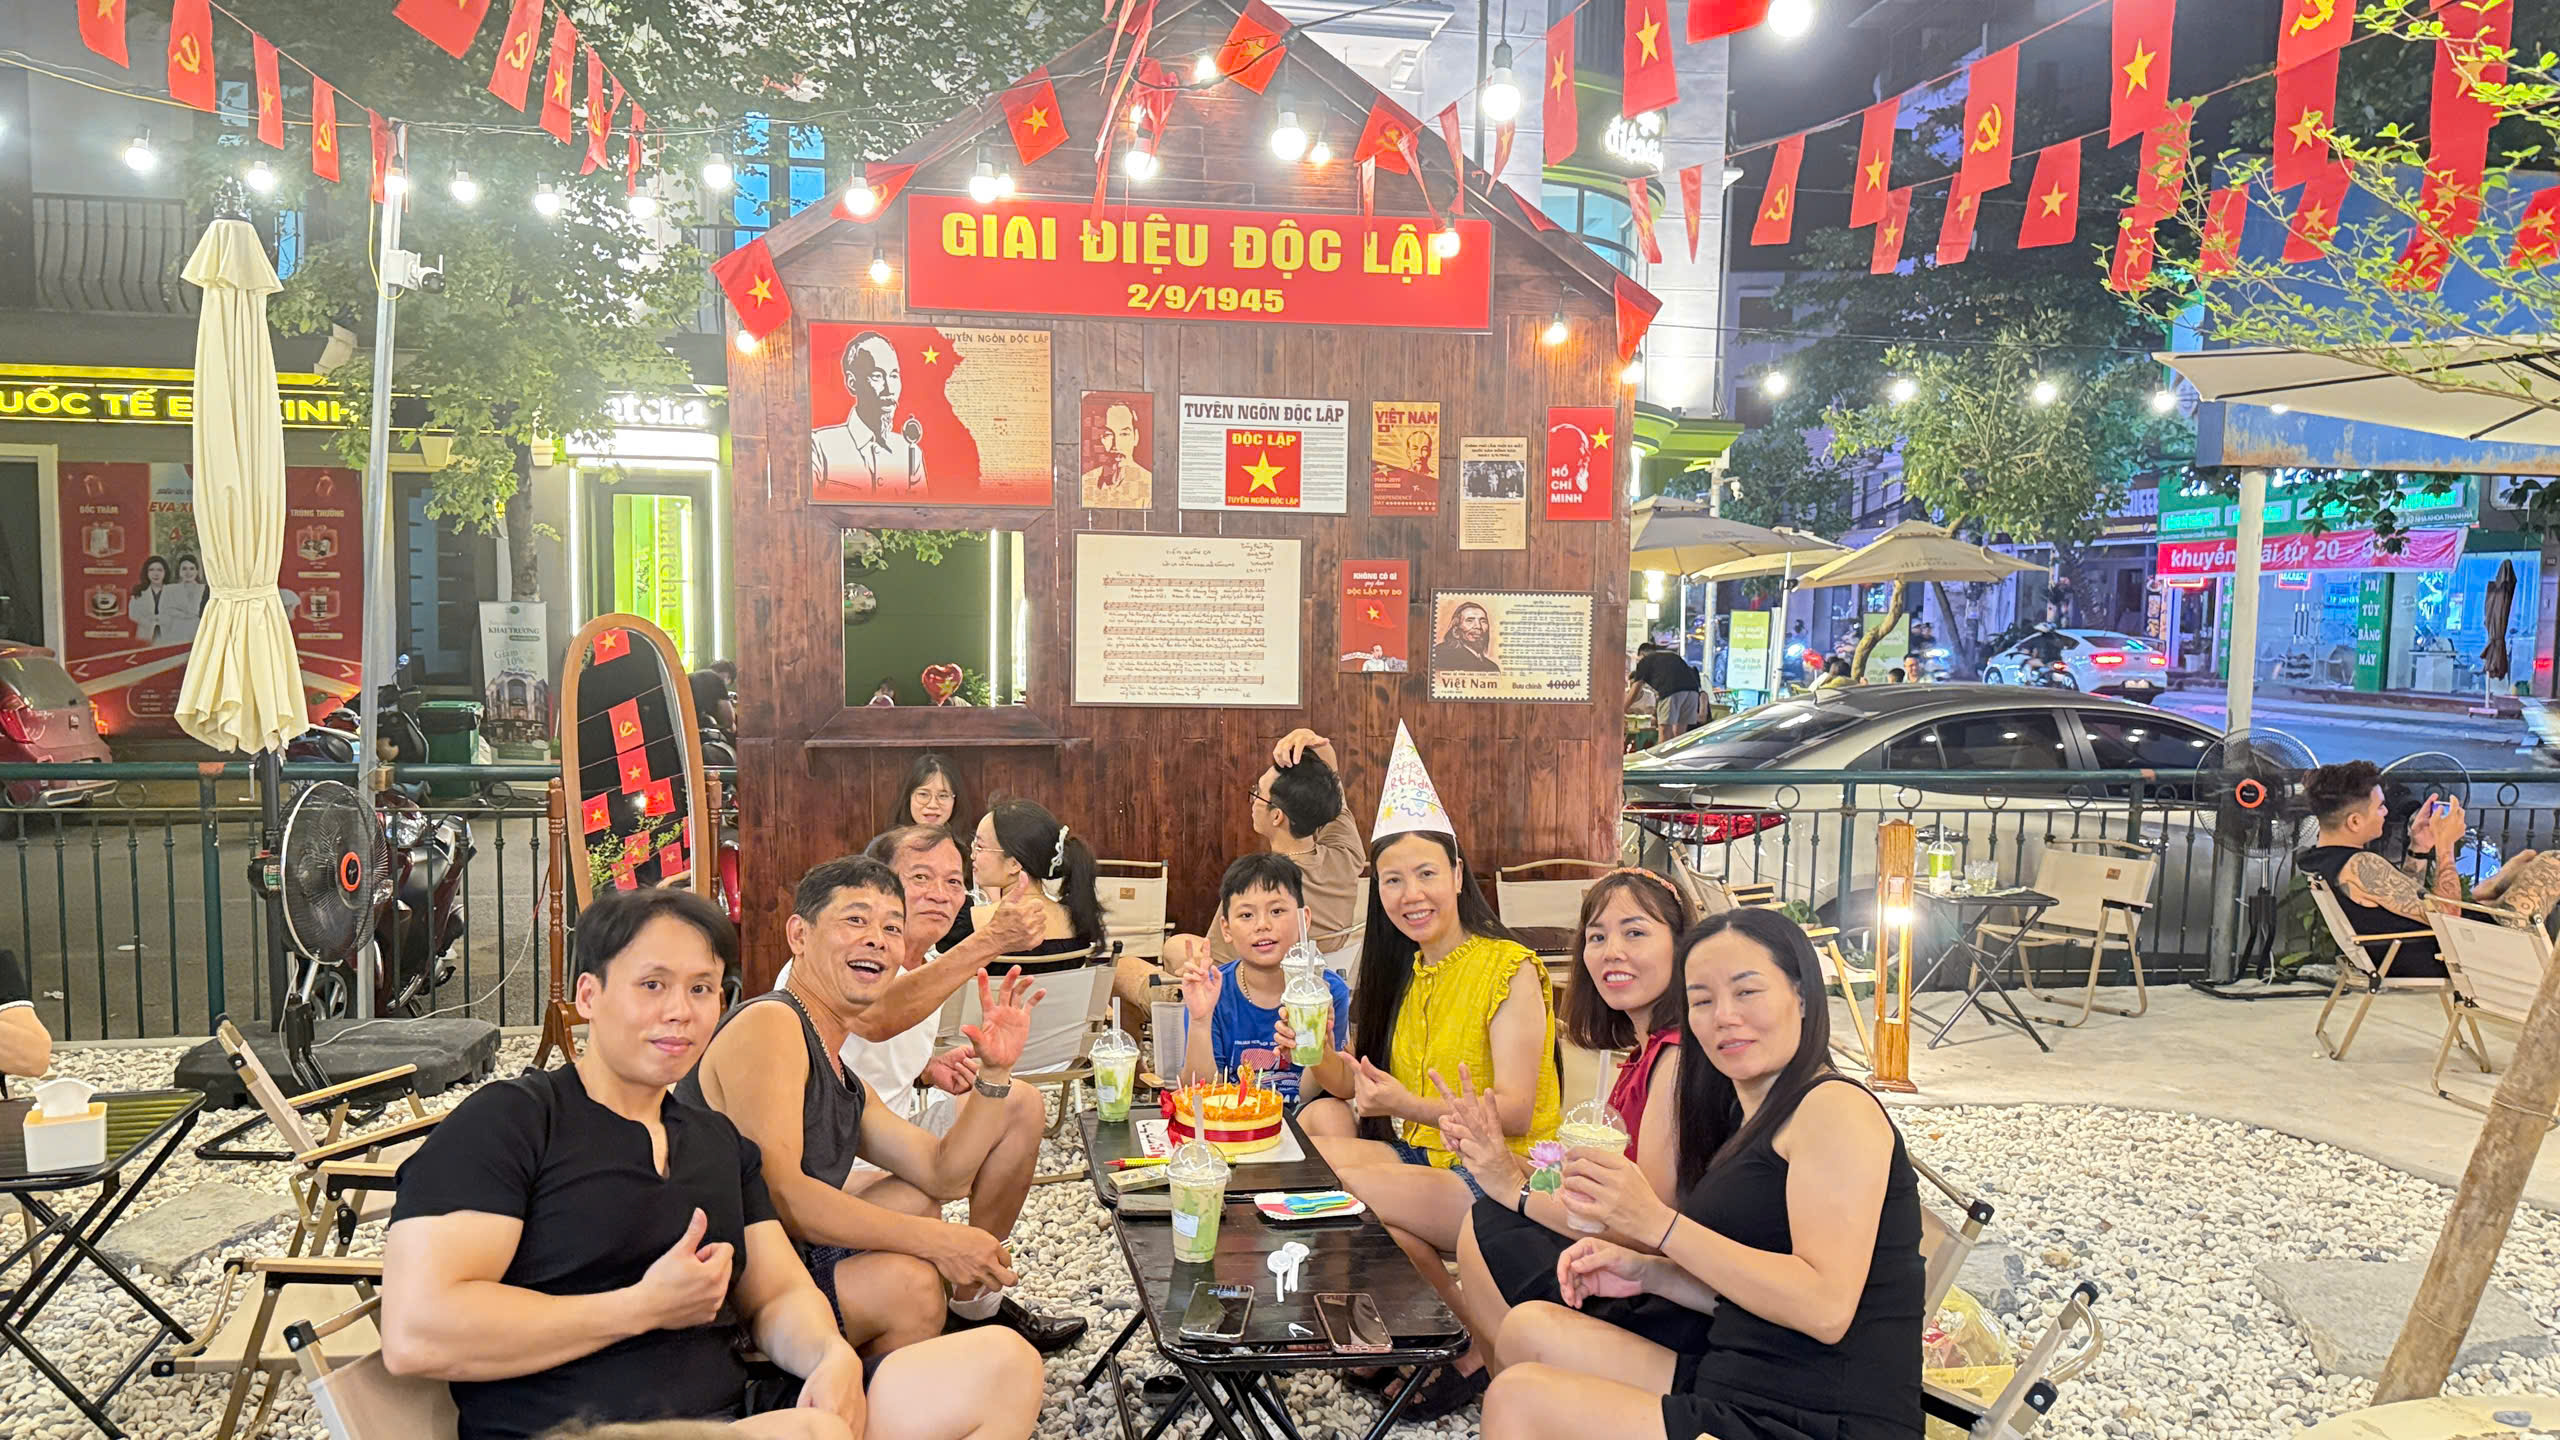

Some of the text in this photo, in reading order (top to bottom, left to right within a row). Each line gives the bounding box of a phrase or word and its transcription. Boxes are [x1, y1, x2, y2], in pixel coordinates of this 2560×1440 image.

[941, 211, 1057, 261] GIAI
[1079, 213, 1209, 275] ĐIỆU
[1229, 220, 1342, 280] ĐỘC
[1126, 282, 1285, 314] 2/9/1945
[977, 333, 1006, 344] NGÔN
[0, 386, 91, 415] UỐC
[100, 388, 156, 417] TẾ
[1184, 400, 1345, 426] TUYÊN NGÔN ĐỘC LẬP
[1408, 411, 1438, 424] NAM
[1231, 431, 1297, 449] ĐỘC LẬP
[1551, 478, 1572, 490] CHÍ
[1551, 493, 1583, 504] MINH
[149, 501, 176, 513] EVA
[2170, 542, 2237, 571] khuyến
[2261, 543, 2279, 563] ãi
[2312, 540, 2340, 561] 20
[2358, 650, 2377, 666] MÁY
[1442, 678, 1498, 691] Việt Nam
